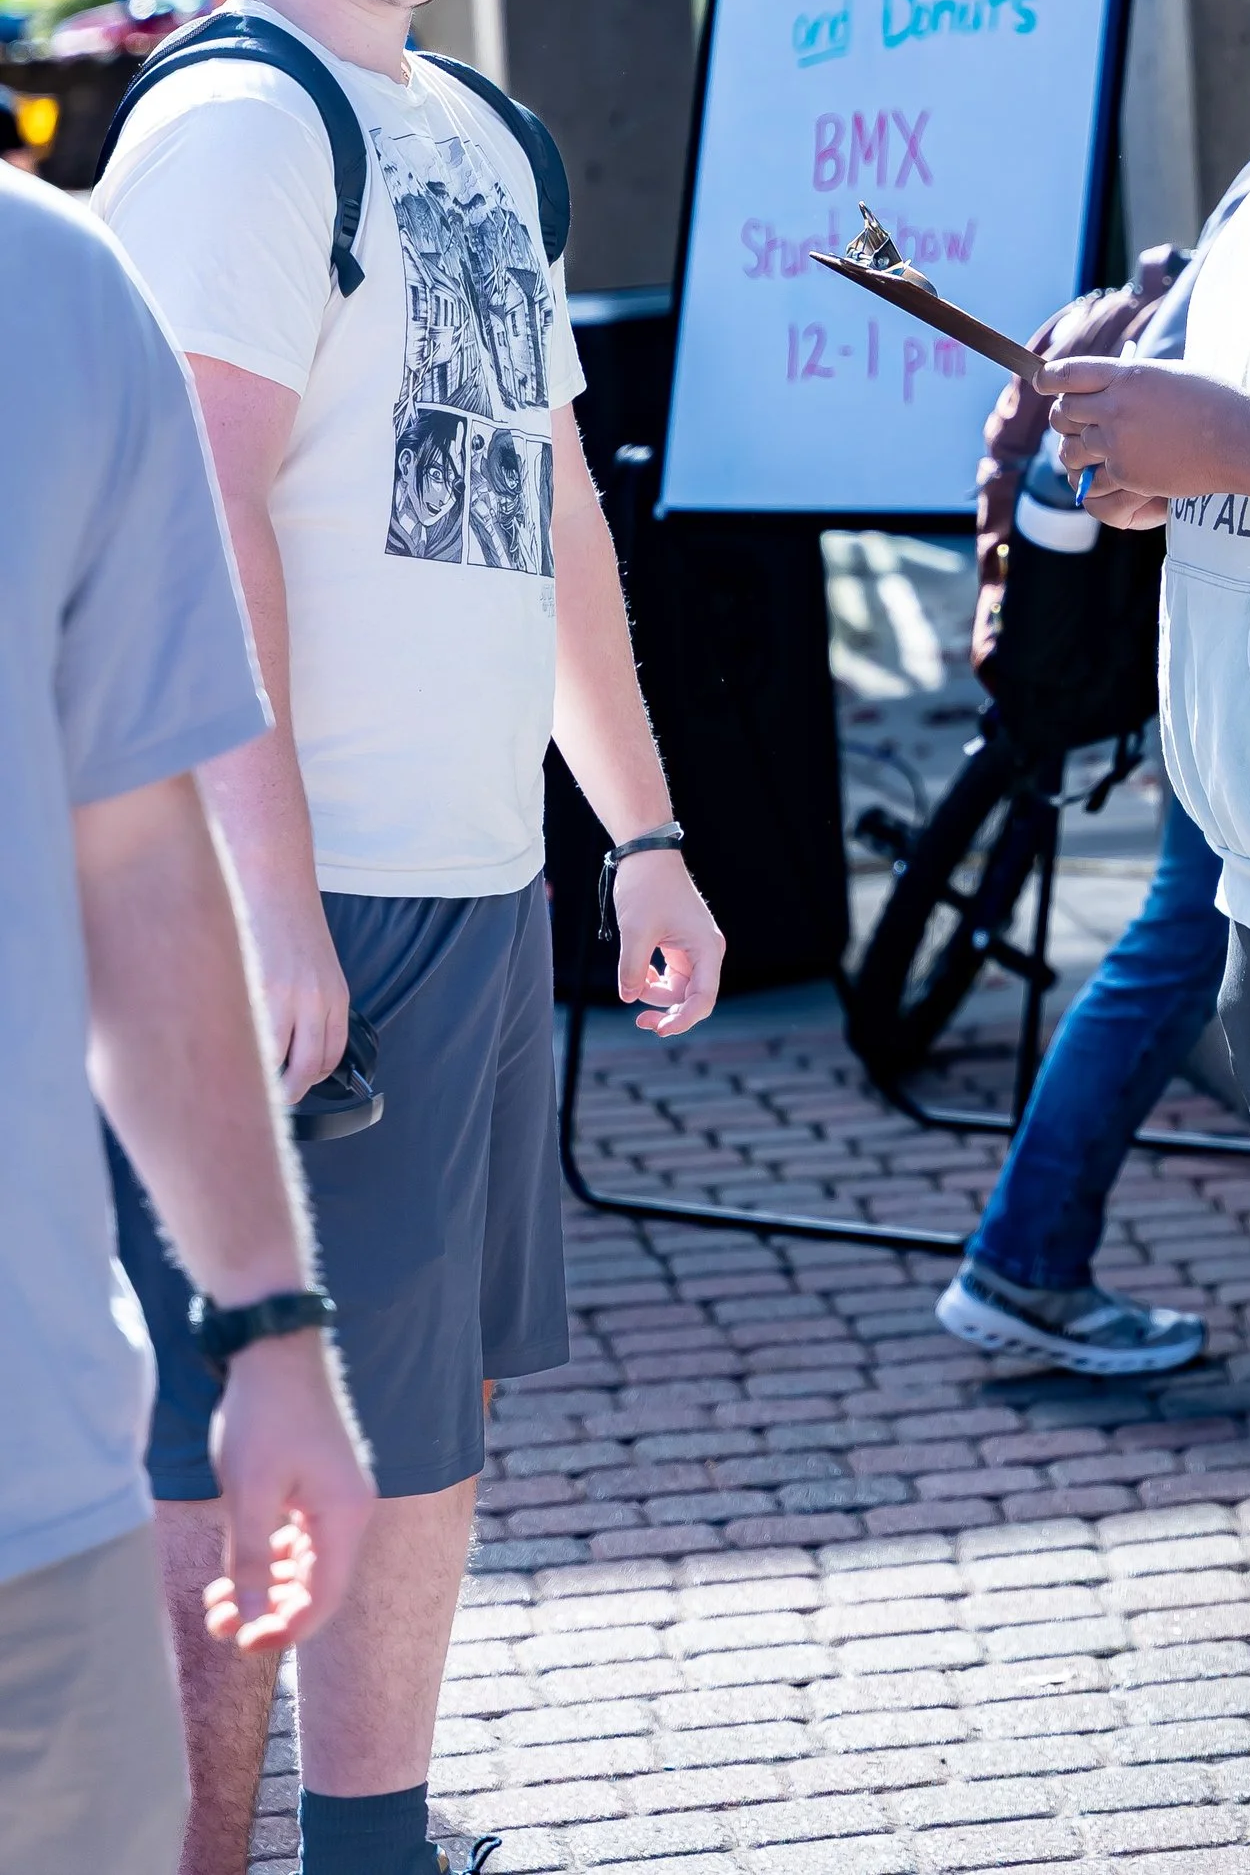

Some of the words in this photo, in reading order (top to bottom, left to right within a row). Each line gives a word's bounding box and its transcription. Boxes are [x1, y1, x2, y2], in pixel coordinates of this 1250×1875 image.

[812, 109, 934, 193] BMX
[874, 208, 978, 265] how
[902, 333, 967, 405] pm
[1170, 493, 1213, 527] ORY
